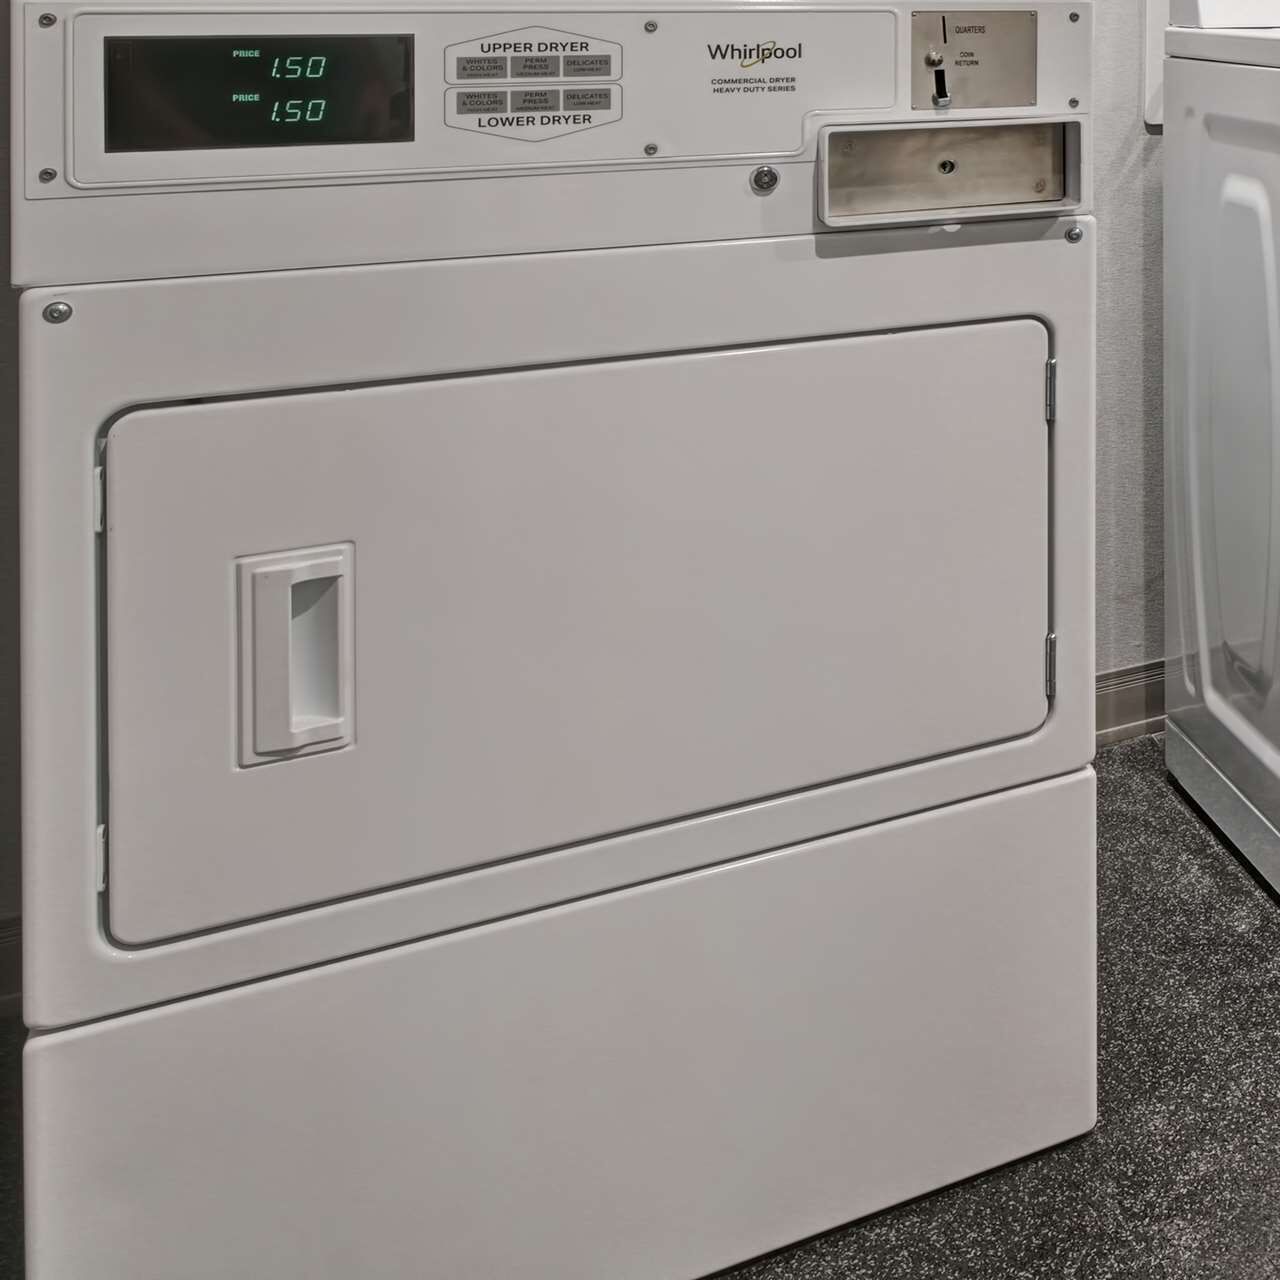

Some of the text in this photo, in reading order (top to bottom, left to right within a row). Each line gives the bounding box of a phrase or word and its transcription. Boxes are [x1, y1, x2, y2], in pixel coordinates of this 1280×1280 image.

[955, 25, 986, 34] QUARTERS
[480, 41, 590, 53] UPPER DRYER
[707, 42, 802, 64] Whirlpool
[232, 49, 326, 78] PRICE 1.50
[566, 58, 609, 66] DELICATES
[232, 94, 326, 122] PRICE 1.50
[478, 114, 592, 128] LOWER DRYER
